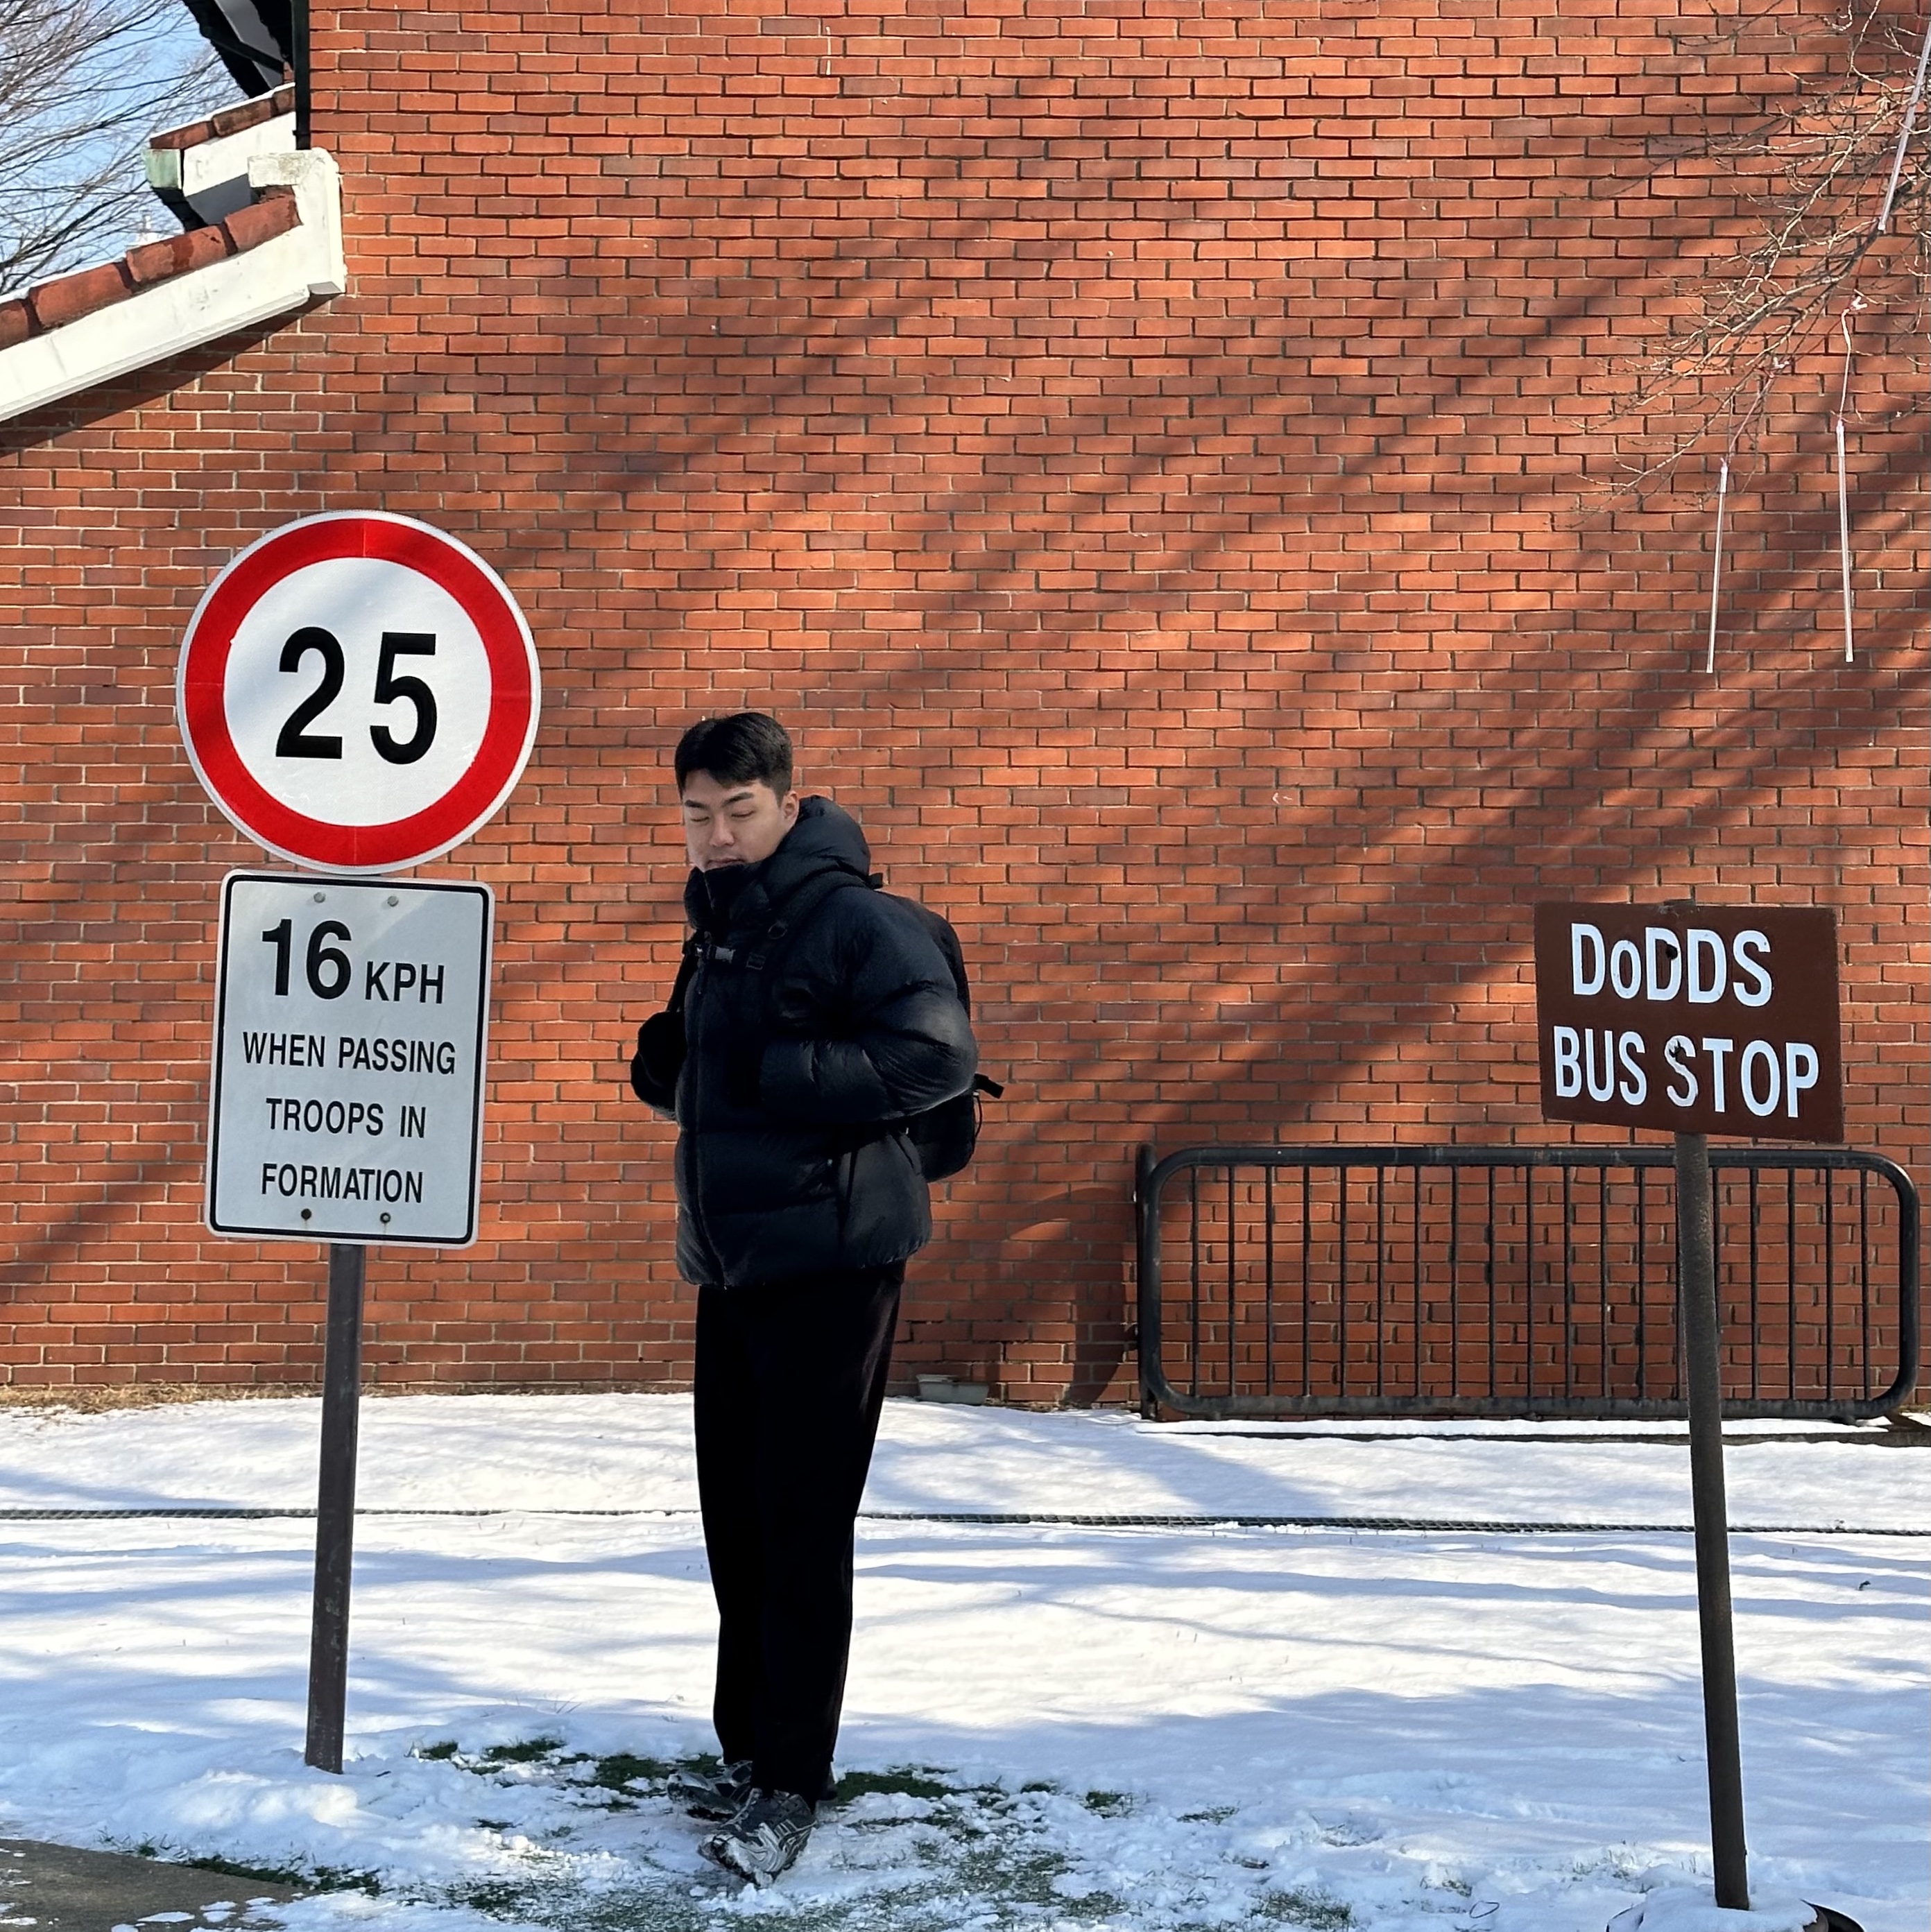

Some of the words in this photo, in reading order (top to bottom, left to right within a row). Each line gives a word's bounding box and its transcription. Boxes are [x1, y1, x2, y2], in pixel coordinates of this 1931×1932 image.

[276, 626, 438, 765] 25
[261, 918, 352, 1000] 16
[364, 960, 445, 1005] KPH
[1570, 922, 1773, 1008] DoDDS
[242, 1030, 325, 1069] WHEN
[338, 1036, 456, 1075] PASSING
[1553, 1025, 1647, 1106] BUS
[1664, 1034, 1820, 1119] STOP
[266, 1097, 384, 1136] TROOPS
[399, 1105, 427, 1139] IN
[261, 1163, 423, 1204] FORMATION
